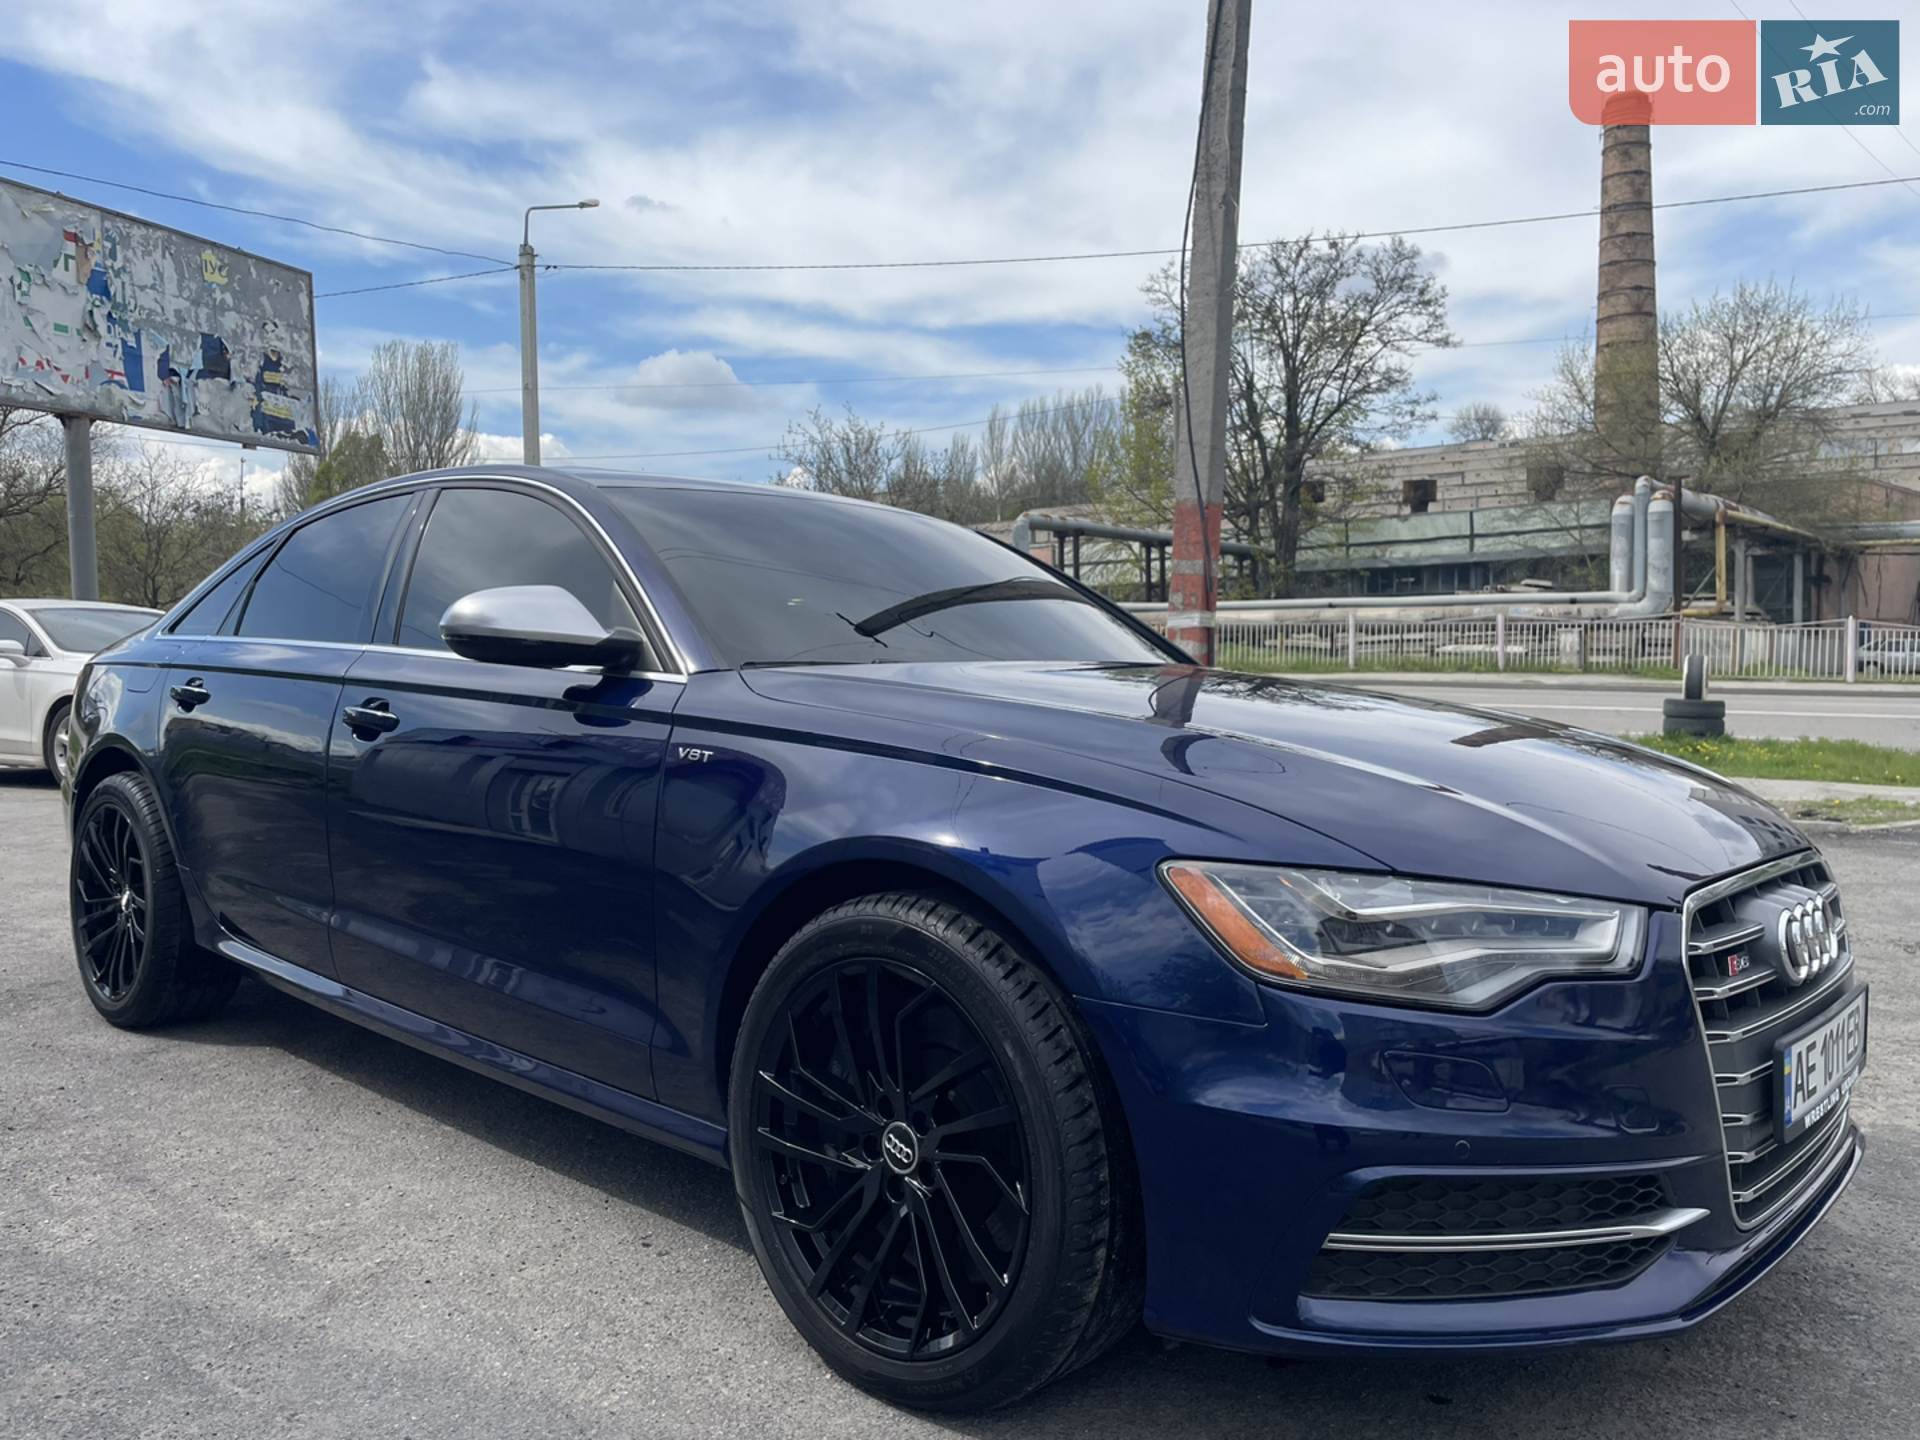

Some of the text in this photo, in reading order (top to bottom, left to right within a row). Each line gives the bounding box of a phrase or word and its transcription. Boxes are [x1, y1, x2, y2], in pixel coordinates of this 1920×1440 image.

[678, 746, 714, 763] V8T
[1732, 955, 1750, 972] S6
[1793, 1040, 1817, 1109] AE
[1820, 1018, 1846, 1087] 1011
[1804, 1087, 1841, 1129] WRESTLING
